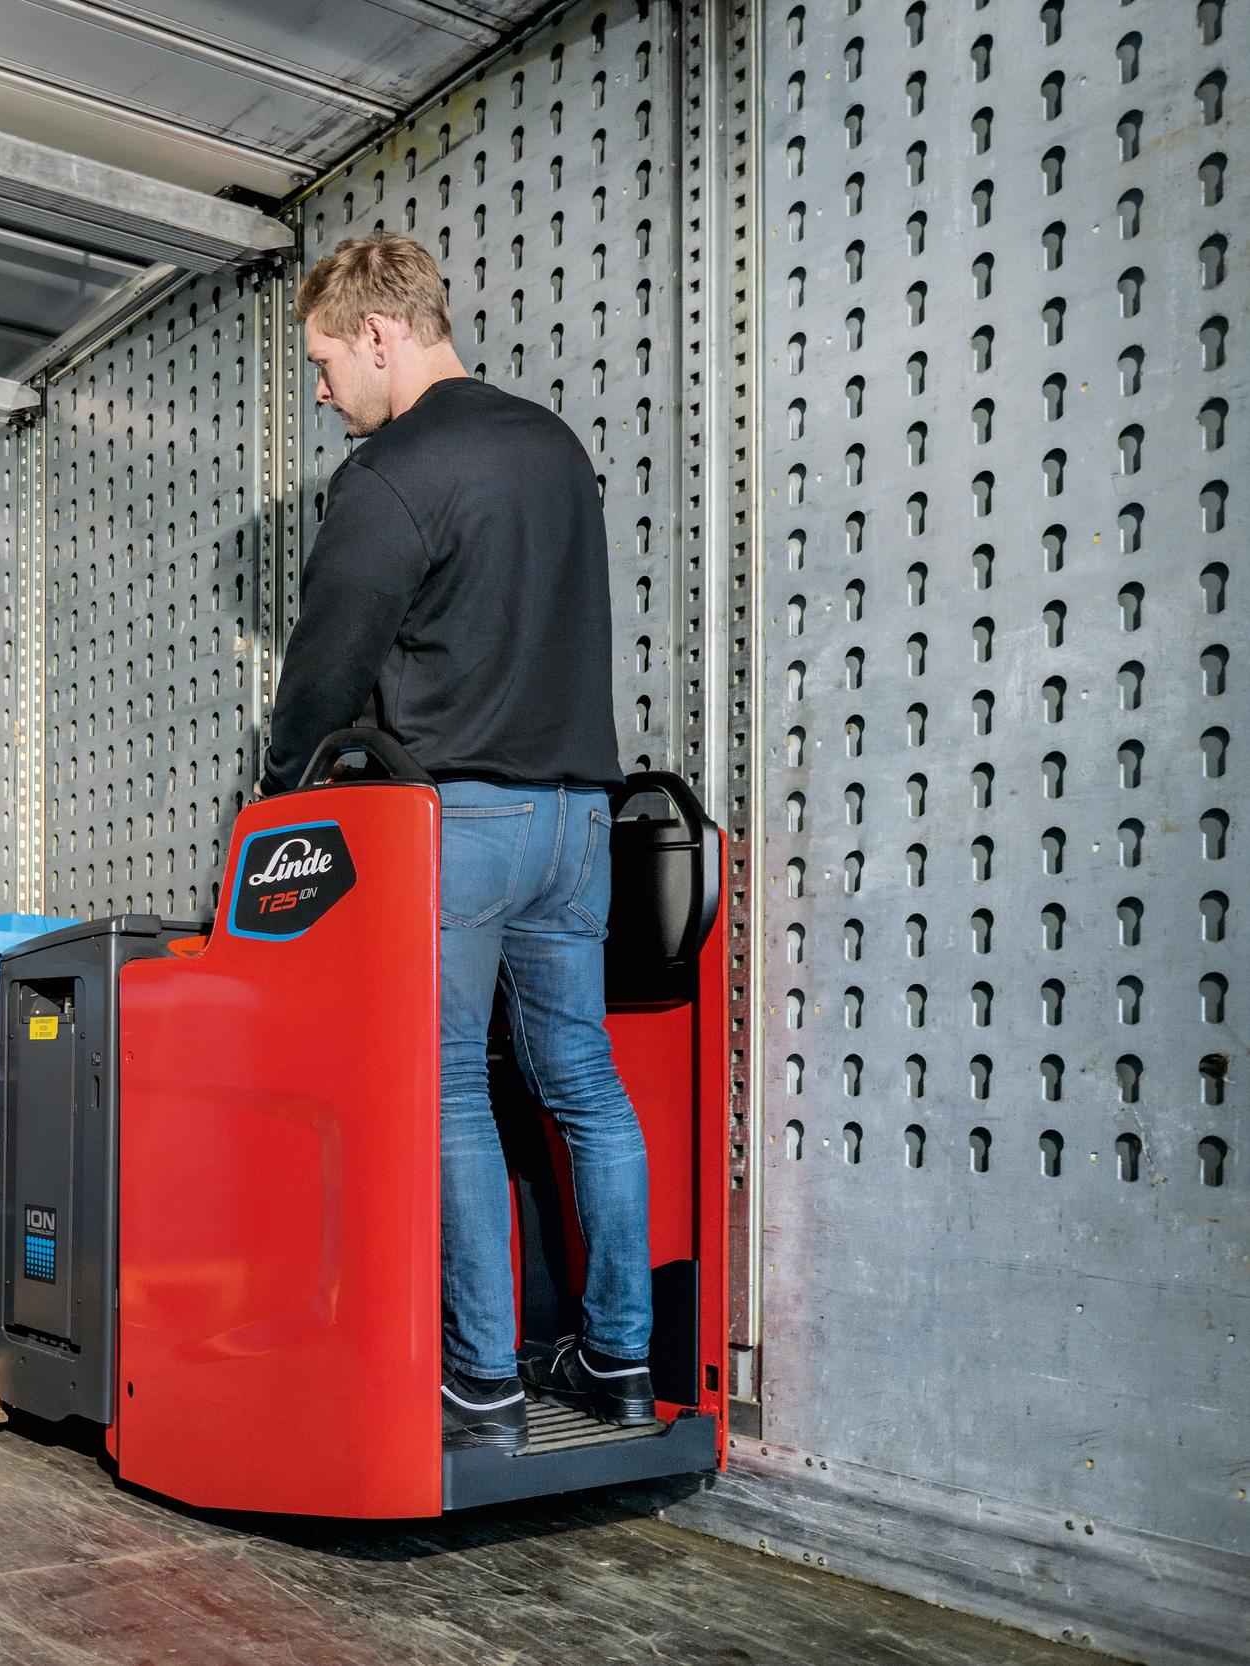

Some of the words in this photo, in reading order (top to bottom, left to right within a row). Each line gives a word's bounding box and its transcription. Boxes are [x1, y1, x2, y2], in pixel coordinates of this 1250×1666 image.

[249, 838, 333, 886] Linde
[259, 890, 299, 914] T25
[299, 886, 318, 900] ION
[26, 1209, 55, 1230] ION
